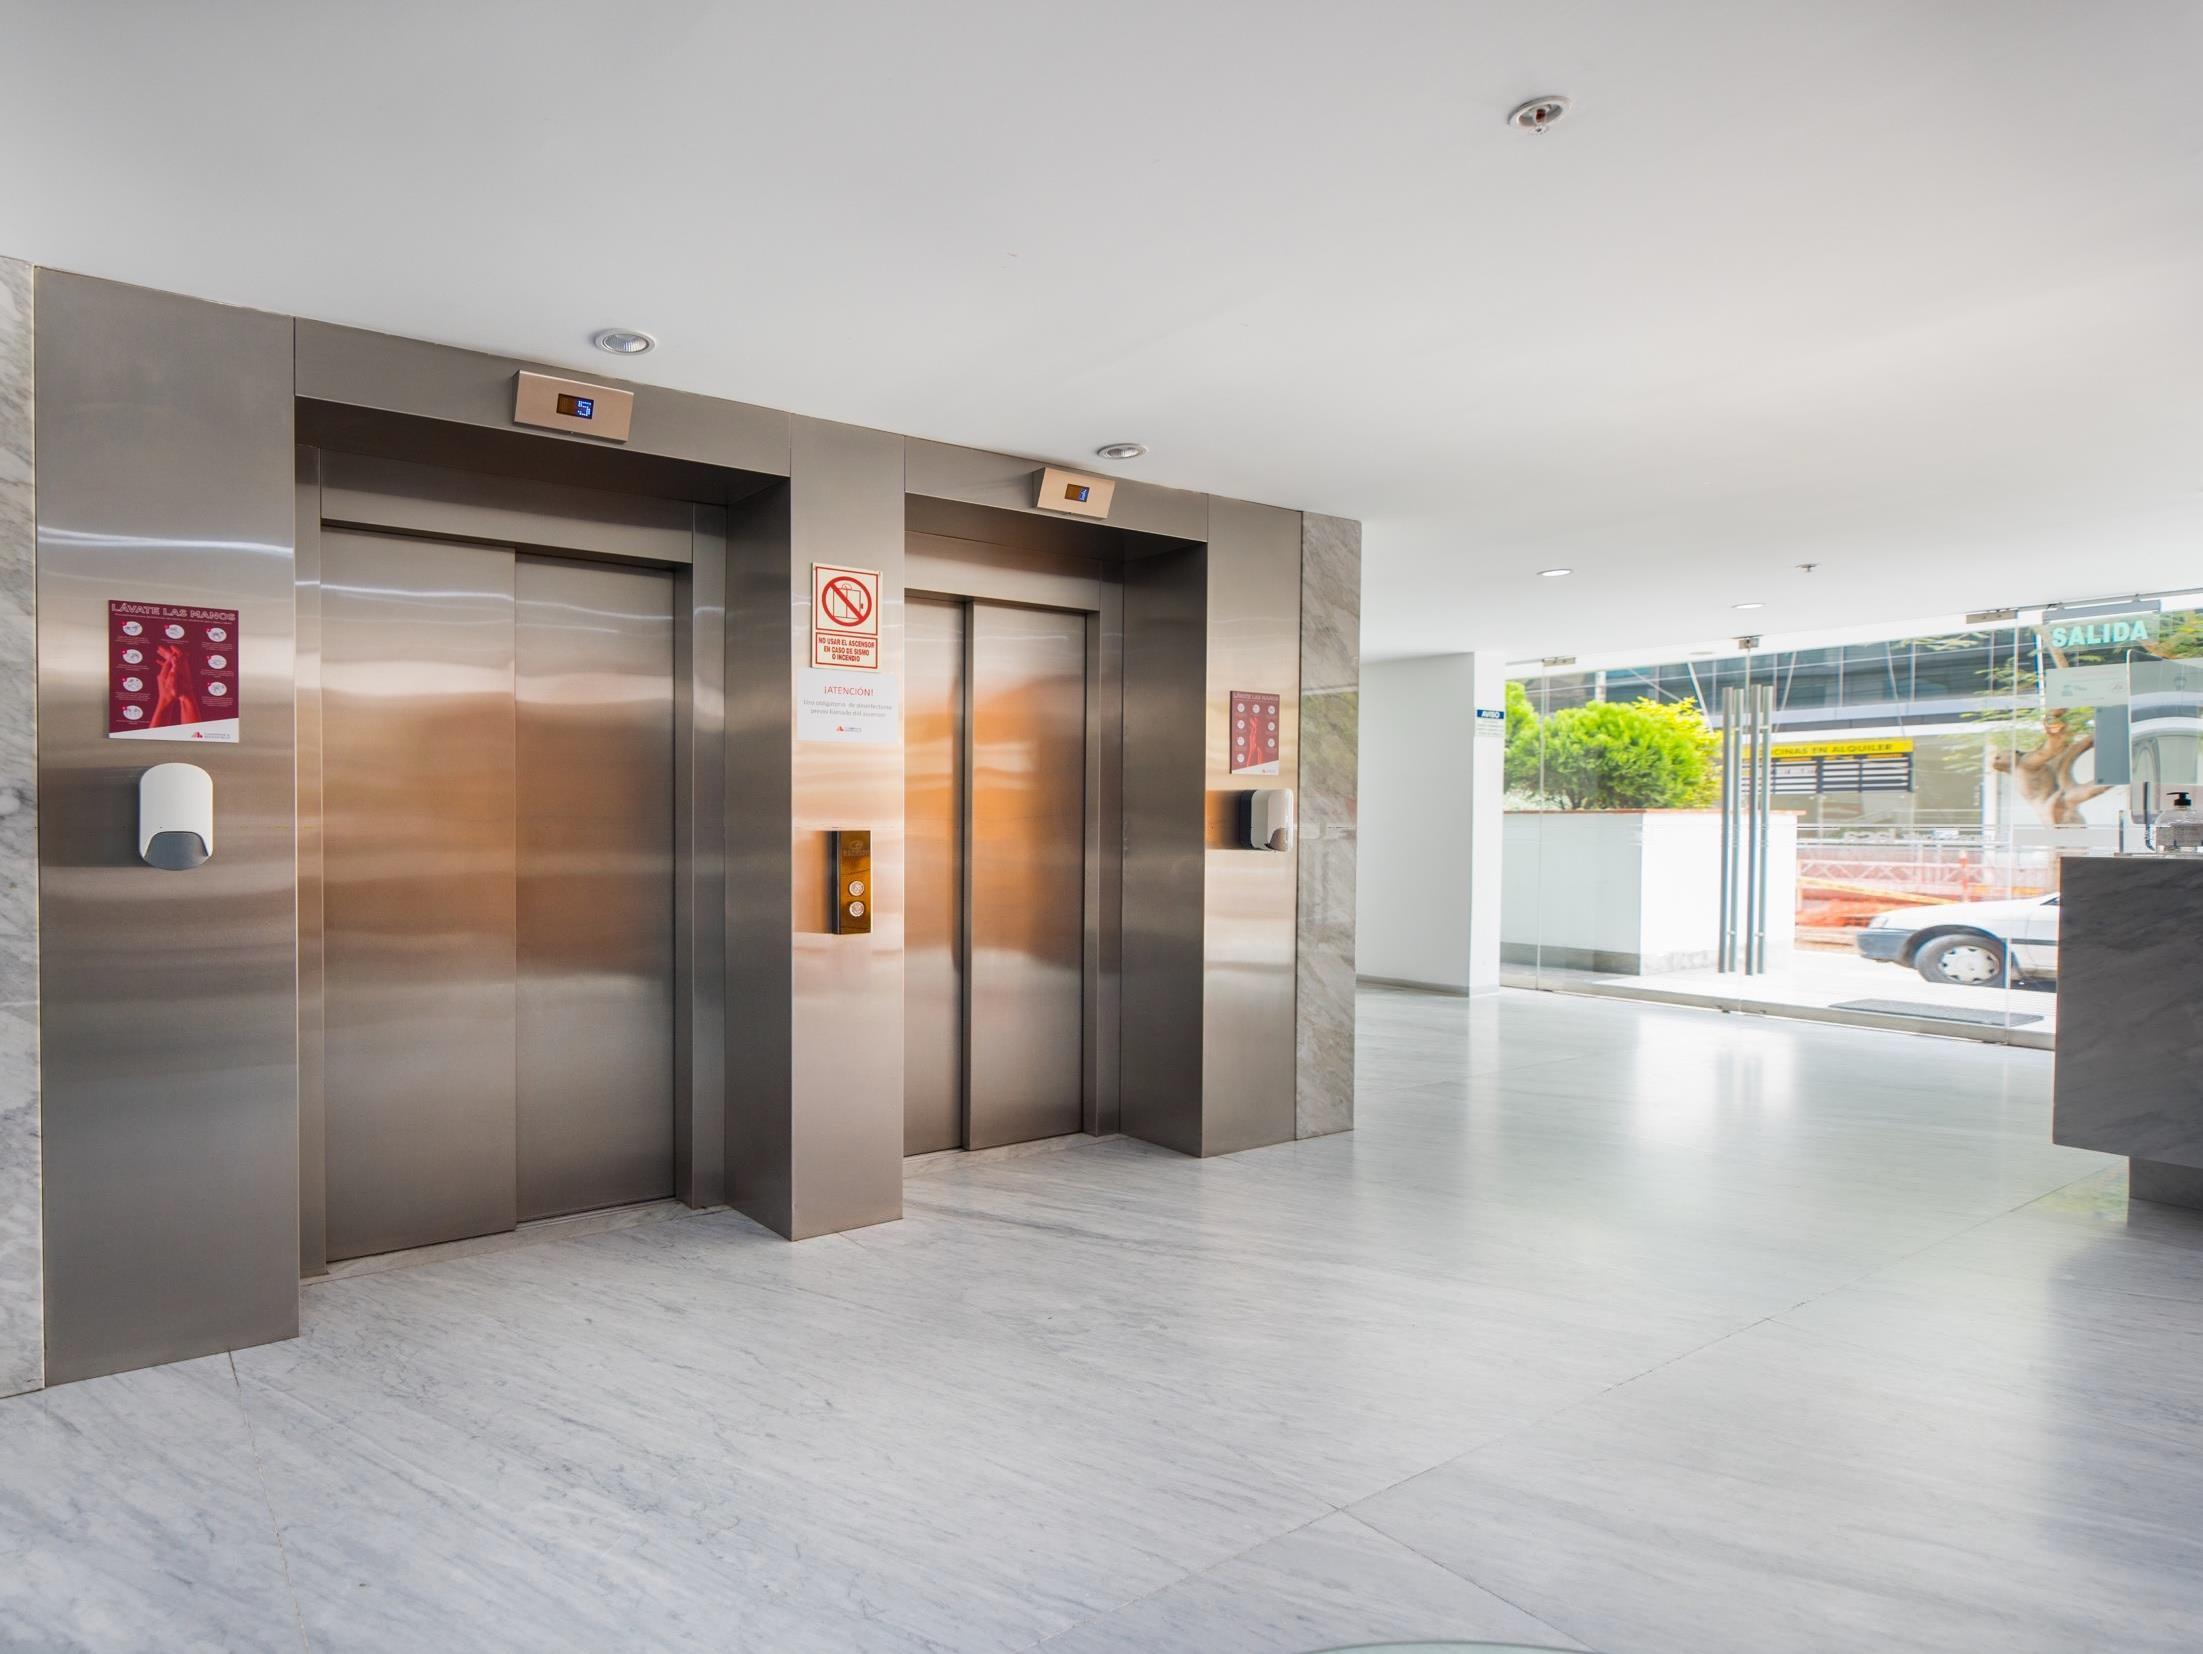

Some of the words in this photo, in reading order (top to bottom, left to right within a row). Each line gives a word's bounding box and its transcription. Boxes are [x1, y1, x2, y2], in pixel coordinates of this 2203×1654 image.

[577, 400, 592, 417] 5
[111, 602, 160, 616] LÁVATE
[162, 607, 187, 617] LAS
[190, 609, 236, 621] MANOS
[2052, 620, 2149, 648] SALIDA
[827, 638, 841, 646] USAR
[848, 640, 875, 648] ASCENSOR
[831, 646, 845, 654] CASO
[846, 647, 853, 655] DE
[854, 648, 870, 656] SISMO
[824, 685, 874, 697] ¡ATENCIÓN!
[1831, 743, 1893, 754] ALQUILER
